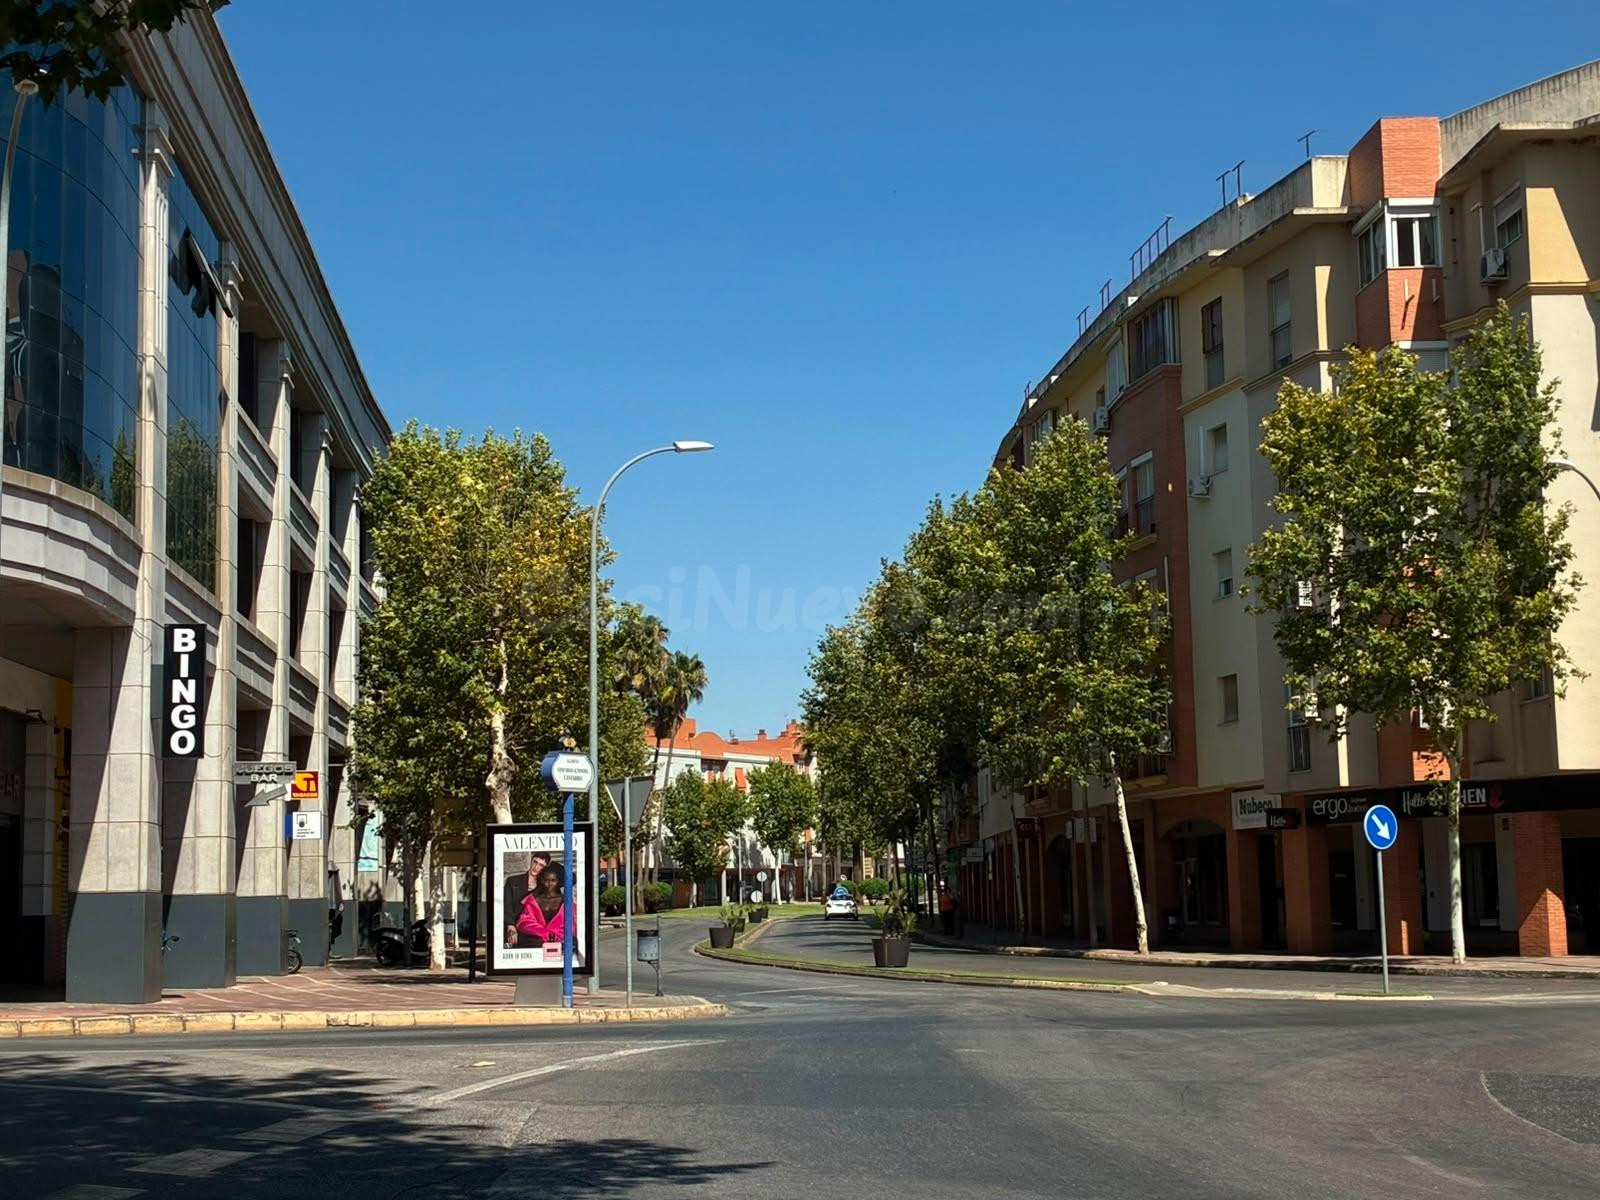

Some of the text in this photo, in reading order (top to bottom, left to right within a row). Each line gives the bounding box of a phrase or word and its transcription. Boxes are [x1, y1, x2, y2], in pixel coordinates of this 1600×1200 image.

[169, 627, 198, 755] BINGO
[235, 764, 295, 775] JUEGOS
[250, 773, 278, 782] BAR
[1312, 797, 1348, 820] ergo
